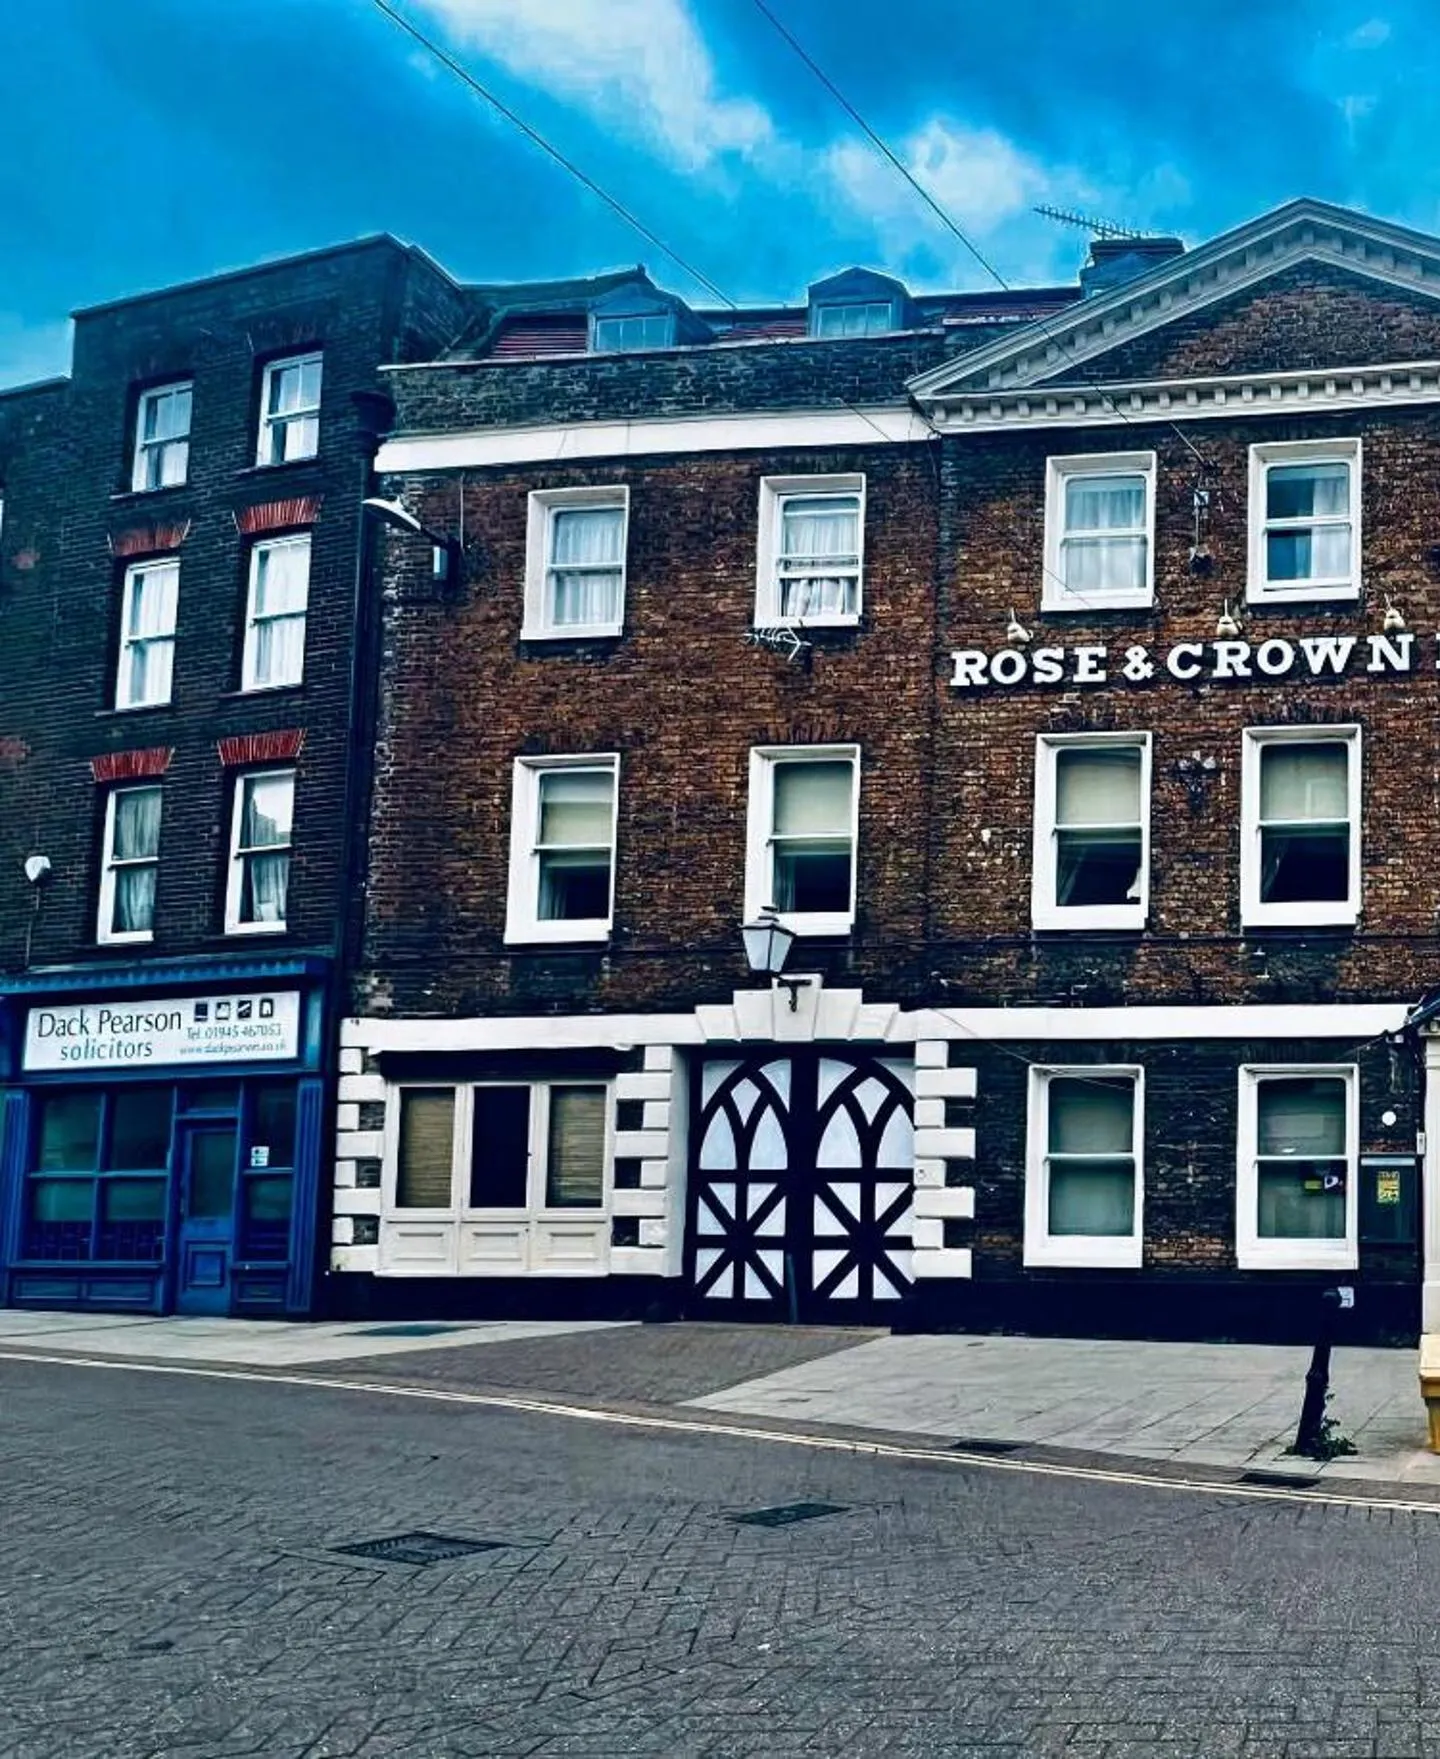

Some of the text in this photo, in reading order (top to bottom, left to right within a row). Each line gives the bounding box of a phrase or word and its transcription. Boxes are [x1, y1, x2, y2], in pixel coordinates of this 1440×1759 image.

[950, 646, 1108, 687] ROSE
[1122, 644, 1154, 682] &
[1166, 633, 1415, 680] CROWN
[38, 1008, 182, 1038] Dack Pearson
[60, 1038, 153, 1061] solicitors
